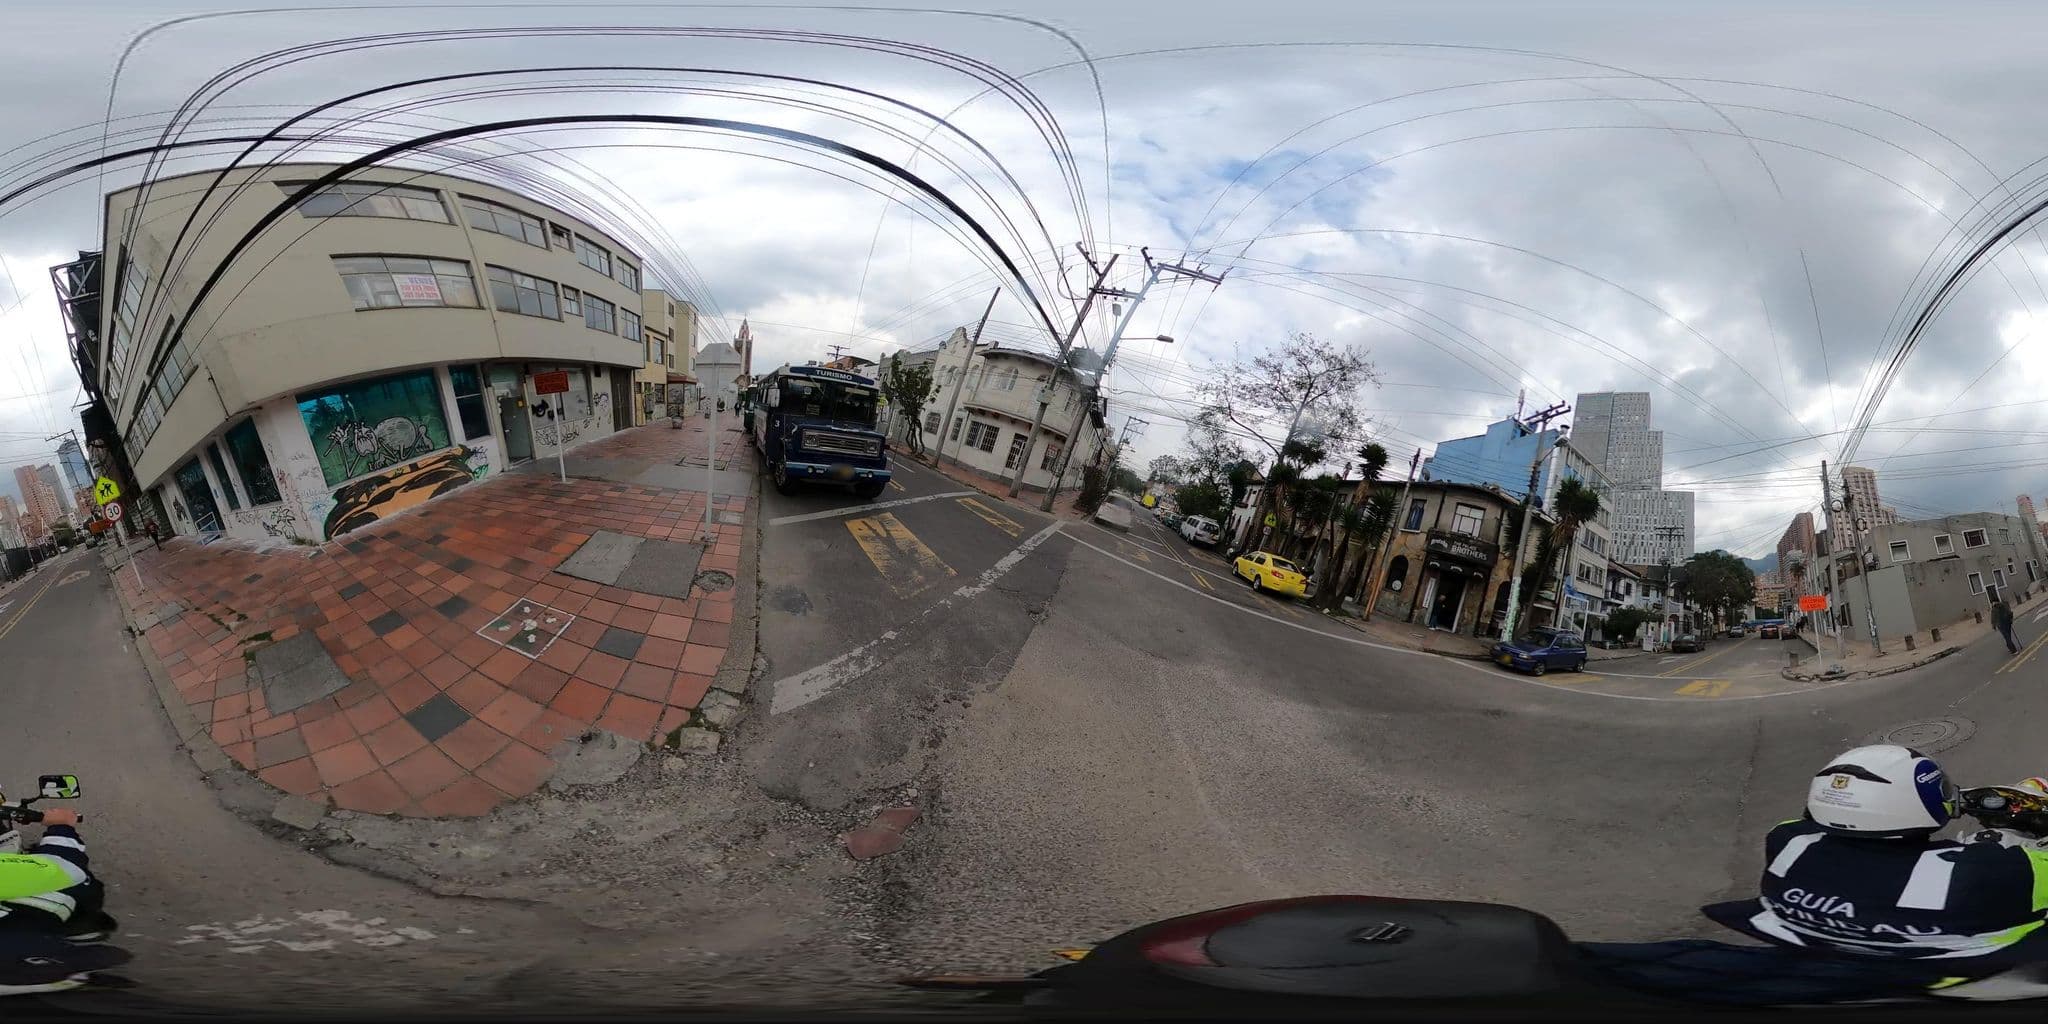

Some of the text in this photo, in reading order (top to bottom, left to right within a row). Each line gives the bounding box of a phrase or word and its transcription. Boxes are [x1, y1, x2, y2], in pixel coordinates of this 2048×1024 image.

[815, 369, 853, 381] TURISMO
[107, 505, 120, 518] 30
[1451, 544, 1488, 561] BROTHERS
[1783, 888, 1855, 918] GUÍA
